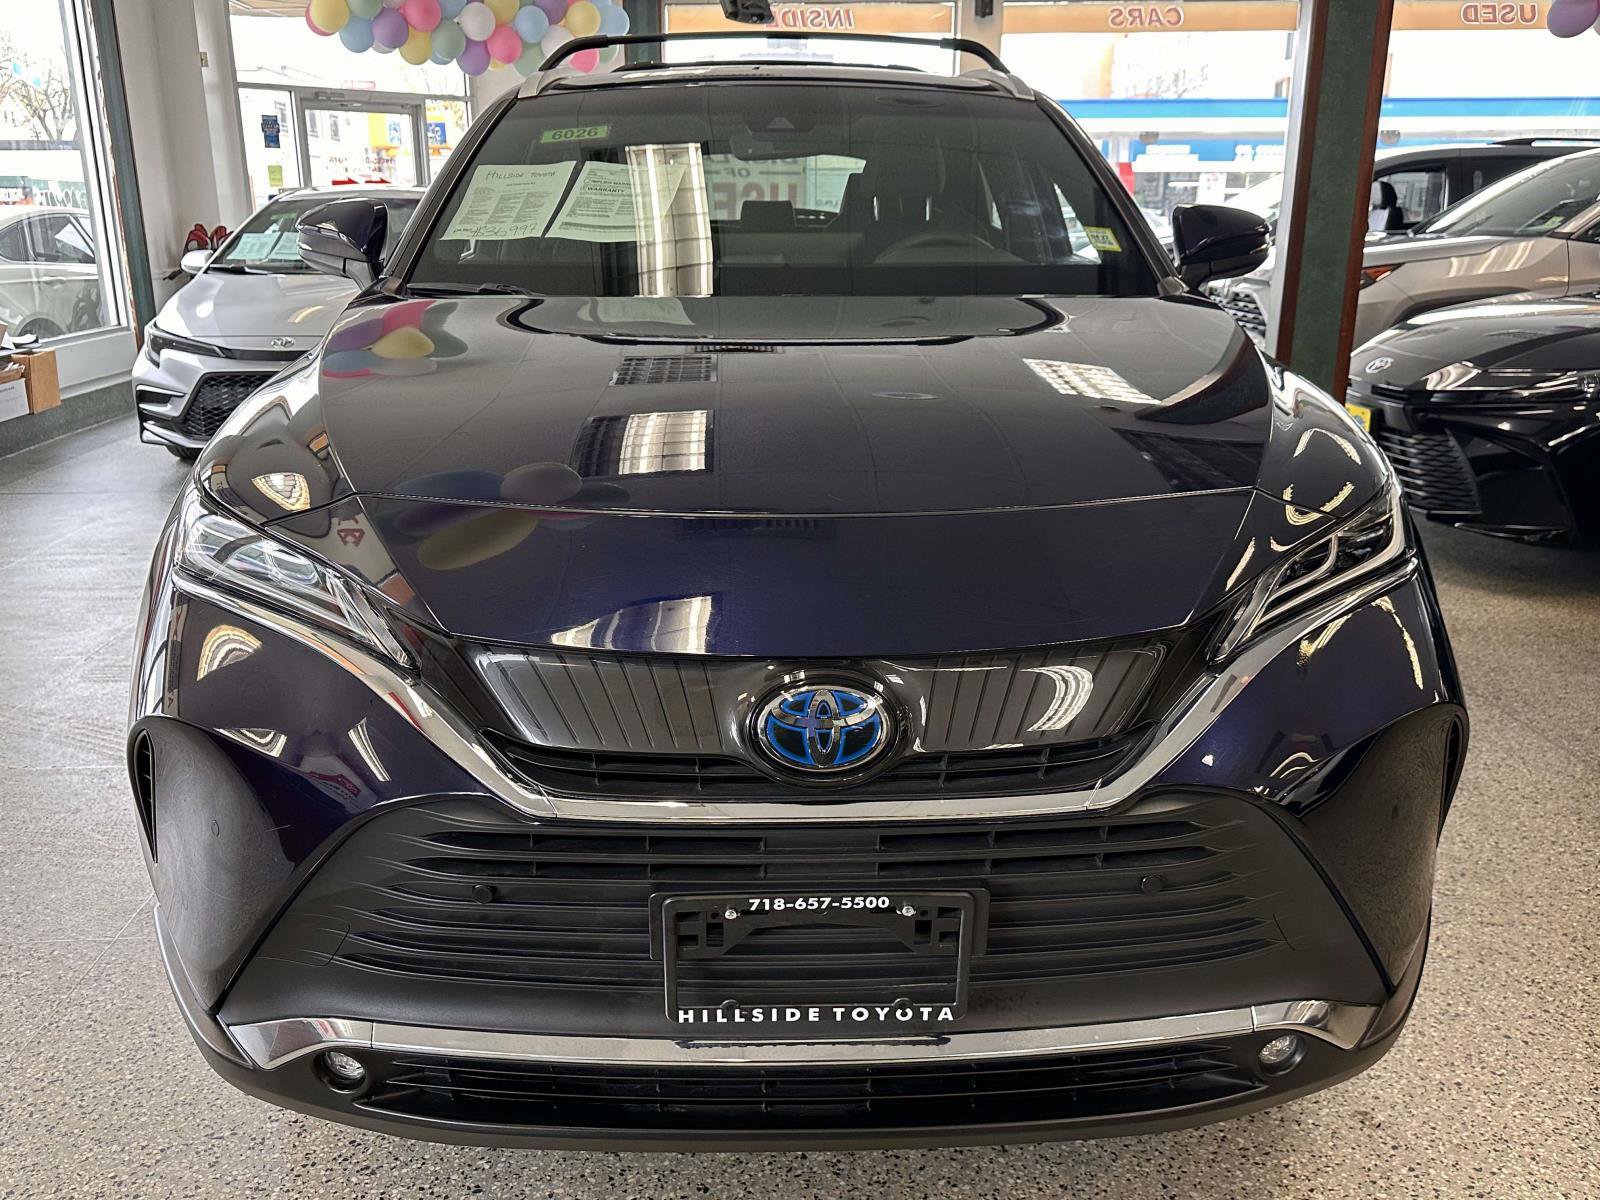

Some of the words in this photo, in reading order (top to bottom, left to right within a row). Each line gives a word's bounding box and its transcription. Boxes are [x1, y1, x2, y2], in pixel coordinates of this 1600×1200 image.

[552, 128, 599, 140] 6026
[748, 896, 891, 911] 718-657-5500
[678, 1007, 820, 1024] HILLSIDE
[832, 1006, 955, 1022] TOYOTA
